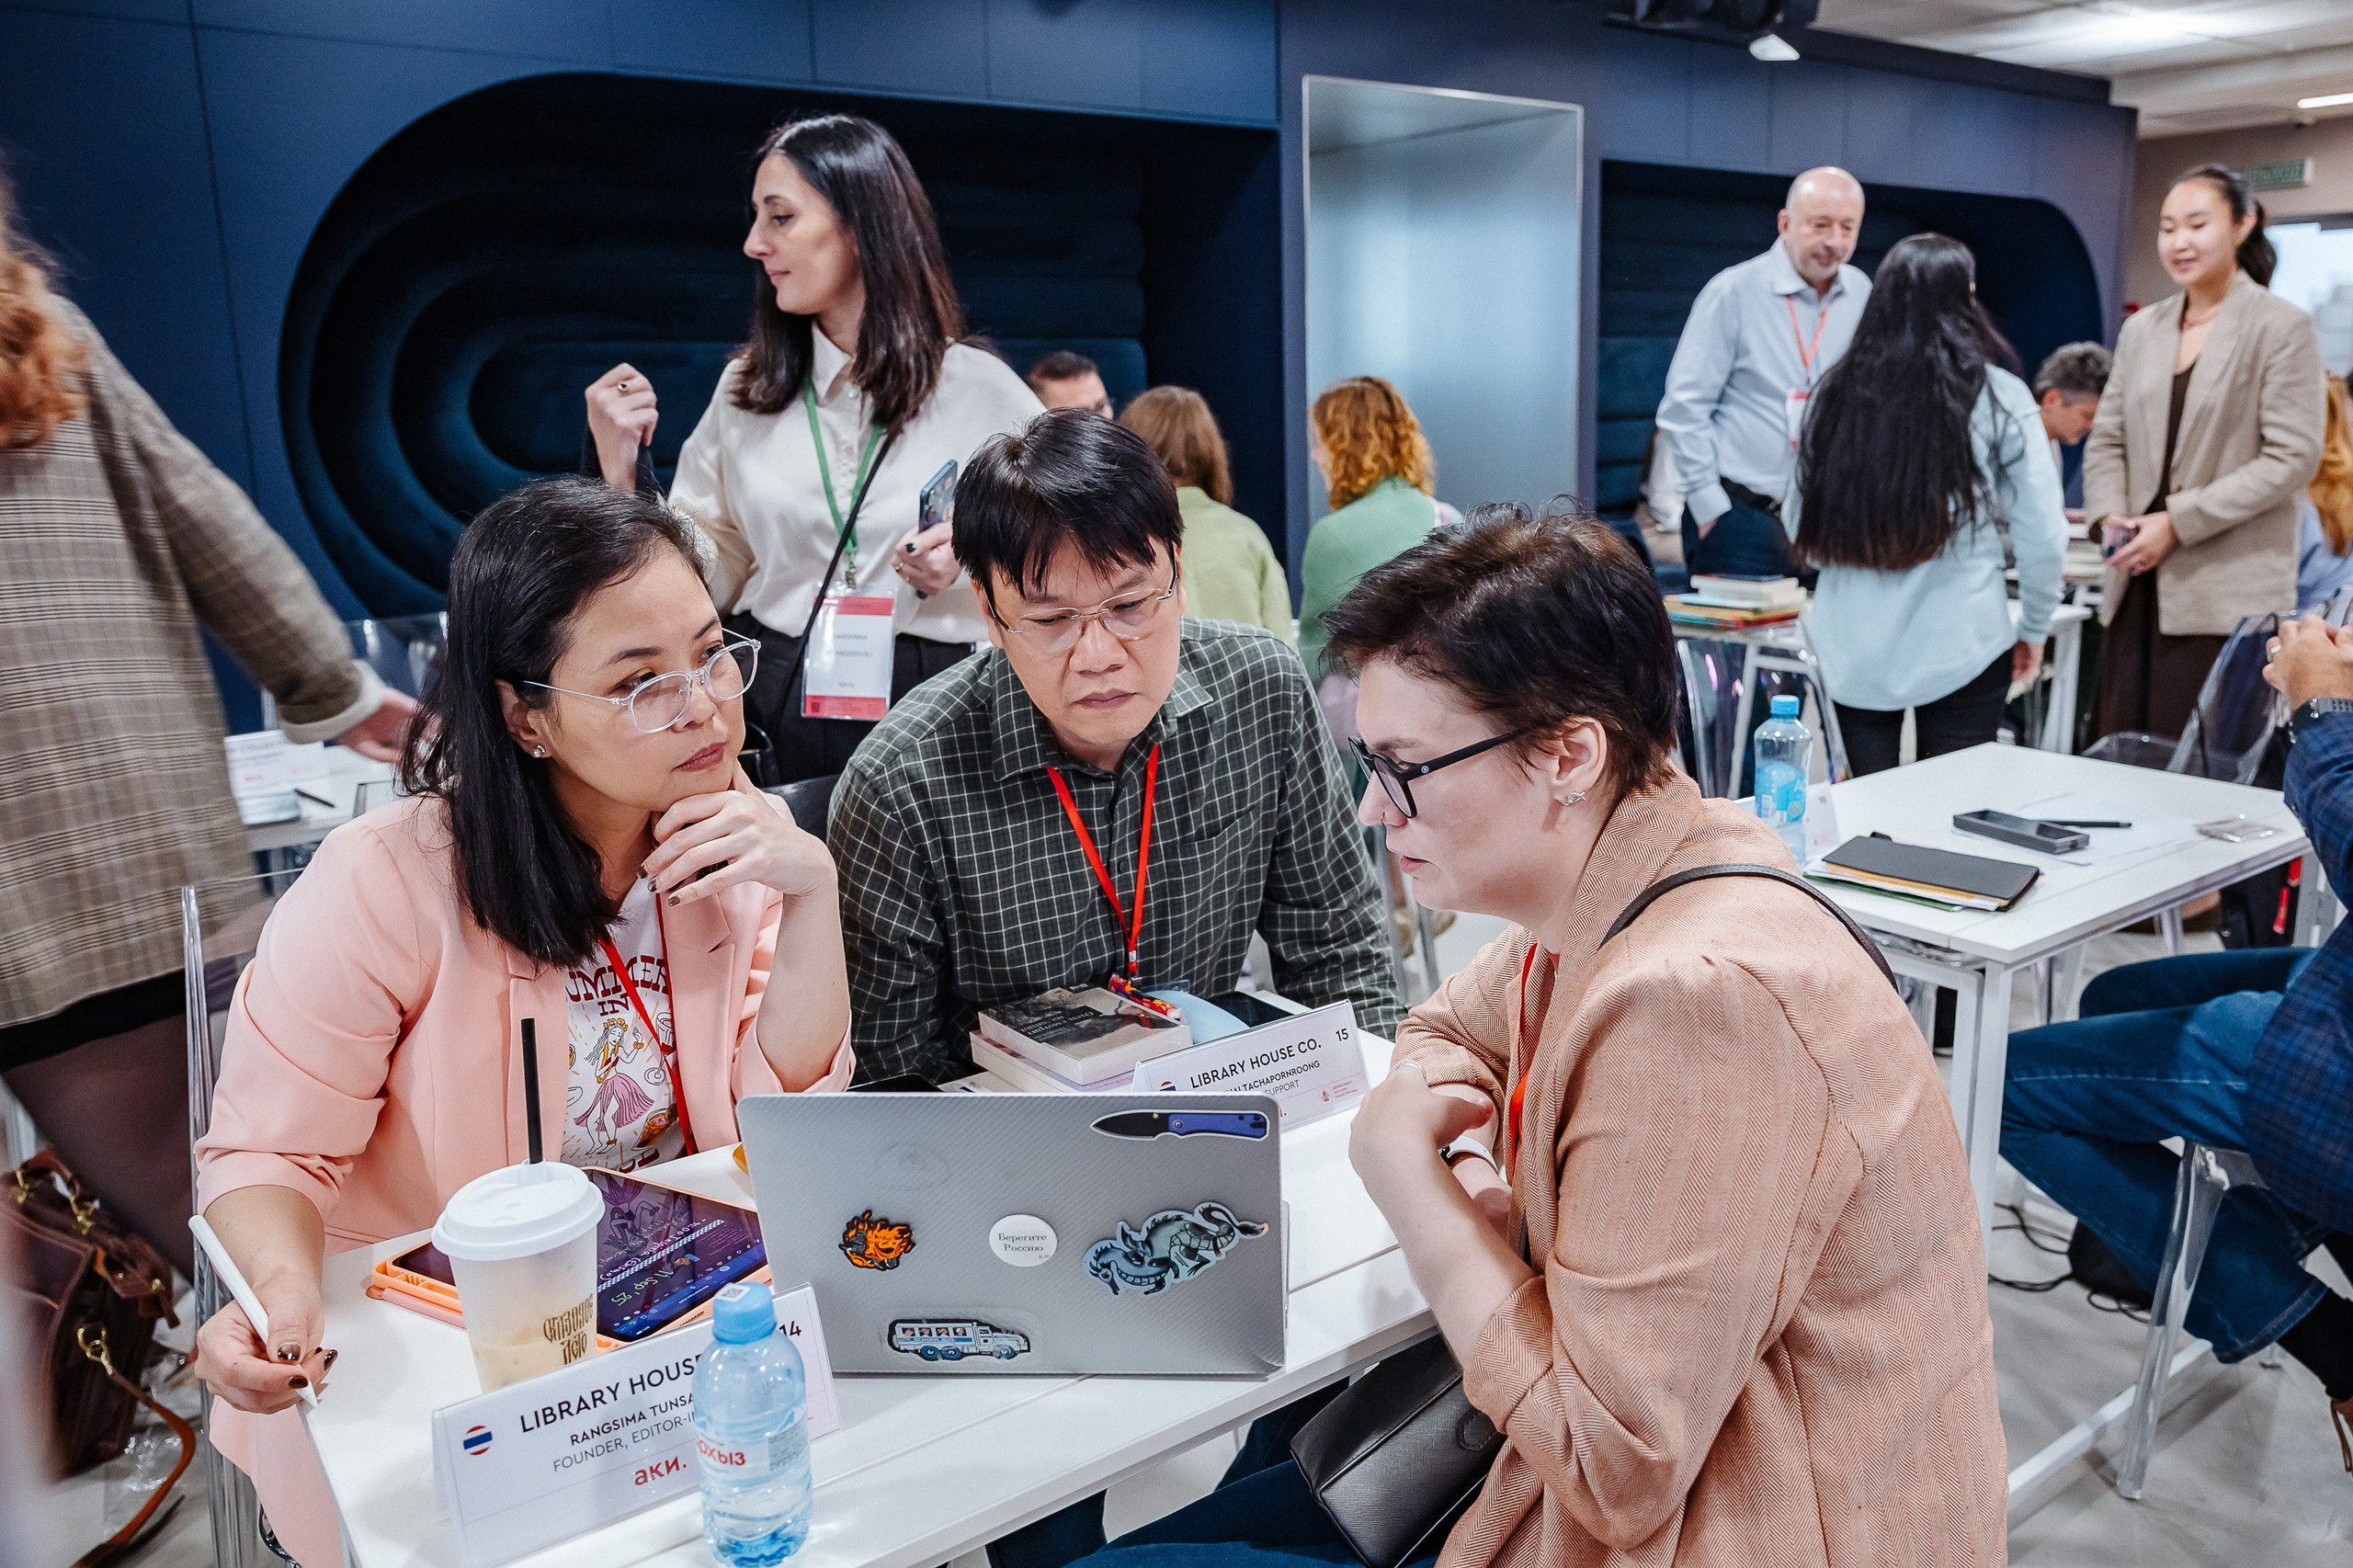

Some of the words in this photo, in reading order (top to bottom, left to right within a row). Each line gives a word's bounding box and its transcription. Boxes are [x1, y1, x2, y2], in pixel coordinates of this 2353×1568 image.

[565, 954, 669, 1003] UMMER
[597, 993, 630, 1017] IN
[1335, 1028, 1349, 1042] 15
[1190, 1060, 1246, 1089] LIBRARY
[1249, 1044, 1296, 1070] HOUSE
[1297, 1038, 1322, 1054] CO.
[998, 1233, 1047, 1243] Берегите
[779, 1320, 801, 1337] 14
[520, 1381, 620, 1433] LIBRARY
[570, 1411, 647, 1446] RANGSIMA
[649, 1392, 694, 1417] TUNSA
[553, 1437, 628, 1472] FOUNDER,
